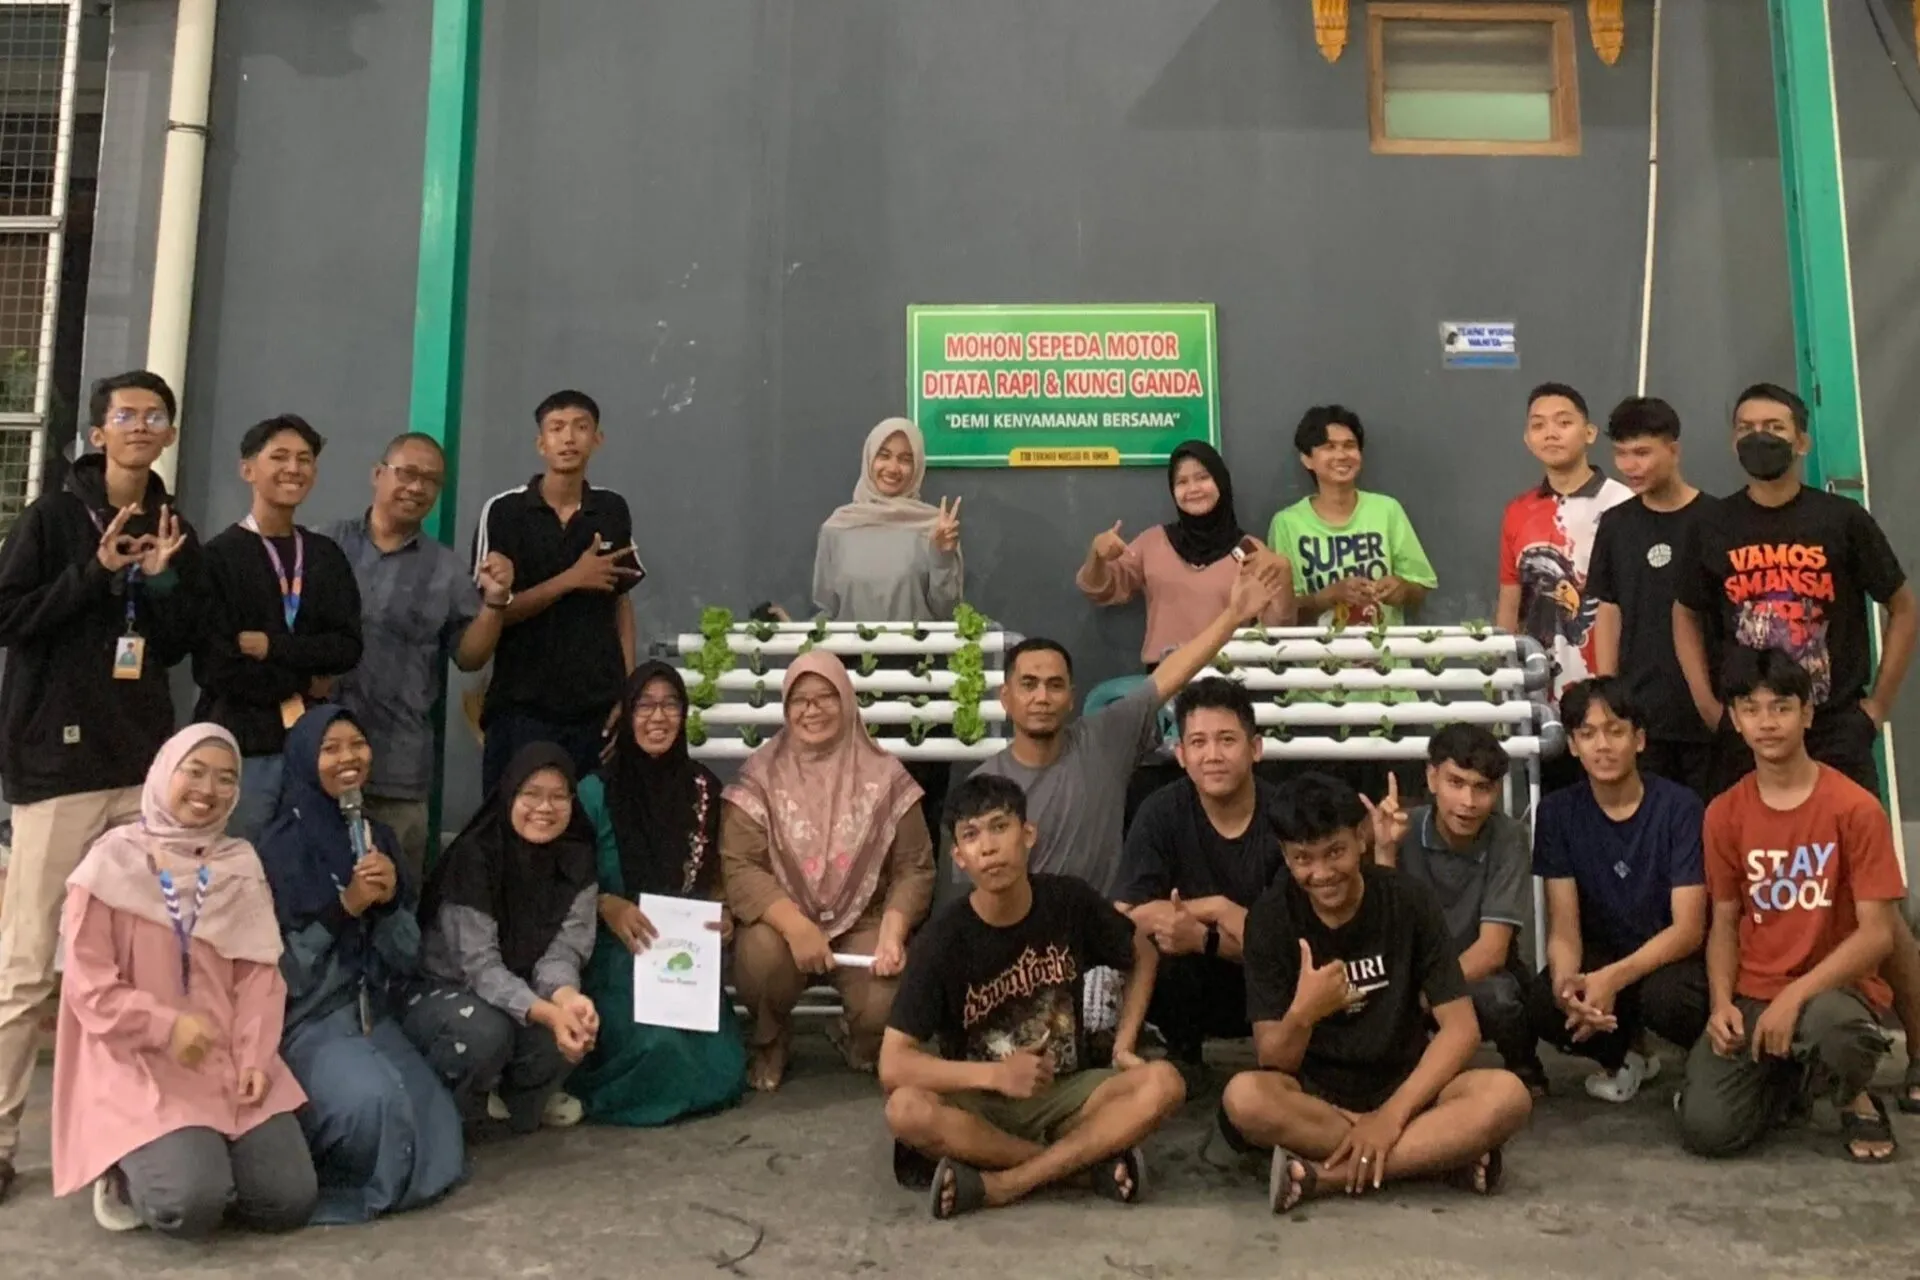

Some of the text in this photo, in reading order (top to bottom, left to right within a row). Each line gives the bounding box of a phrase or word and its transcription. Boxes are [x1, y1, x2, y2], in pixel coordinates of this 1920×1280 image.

[946, 332, 1178, 360] MOHON SEPEDA MOTOR
[923, 370, 1202, 398] DITATA RAPI & KUNCI GANDA
[994, 413, 1098, 428] KENYAMANAN
[1299, 532, 1386, 577] SUPER
[1727, 544, 1827, 572] VAMOS
[1724, 568, 1835, 604] SMANSA
[1747, 842, 1835, 881] STAY
[1749, 878, 1832, 911] COOL
[1344, 955, 1385, 982] IRI
